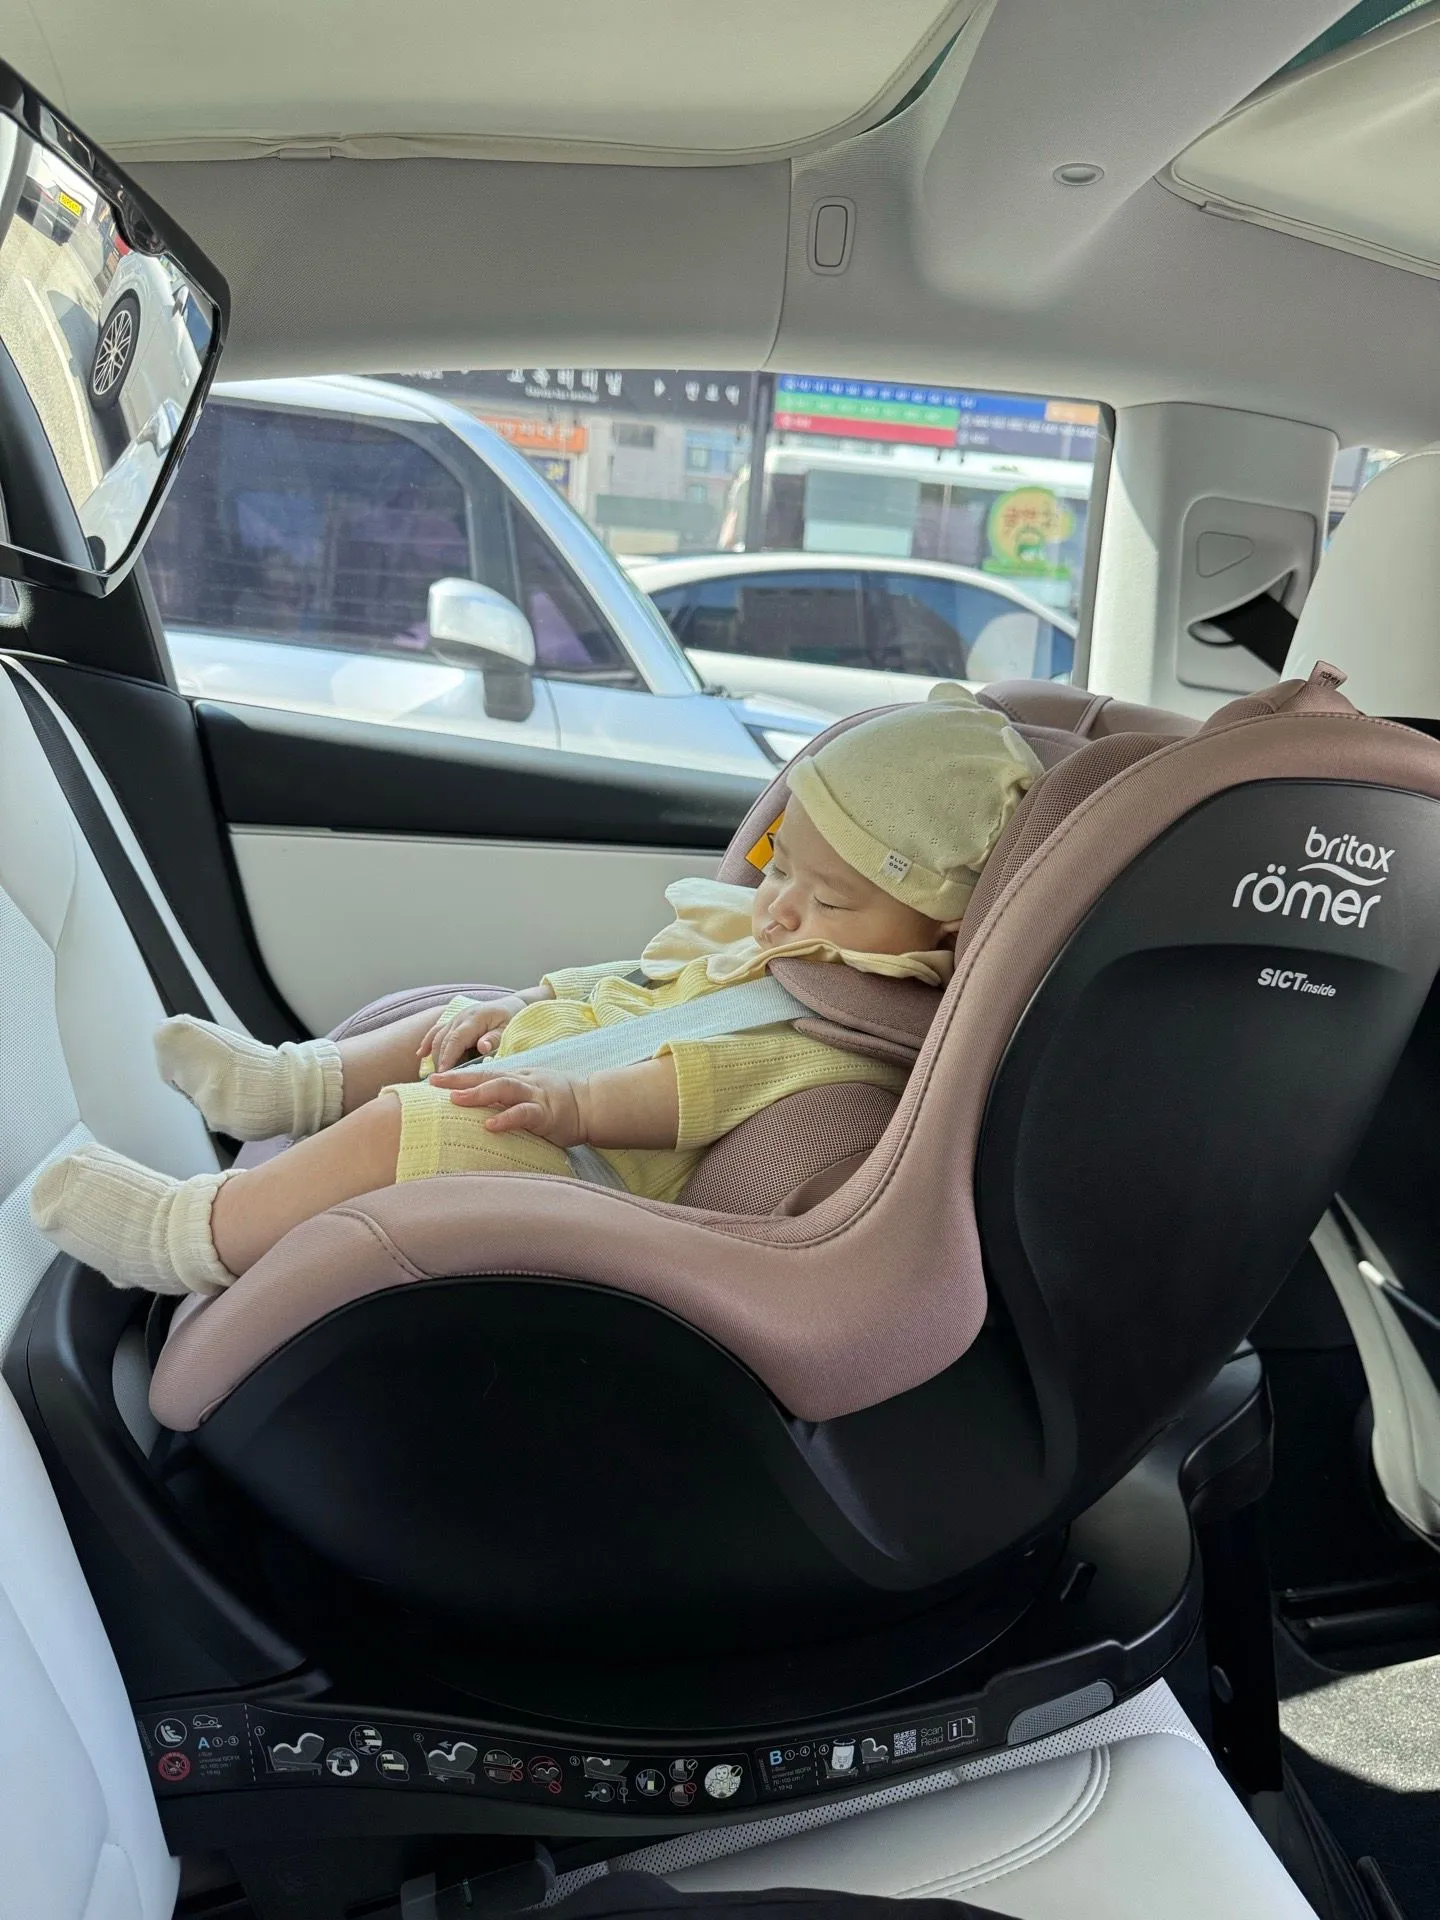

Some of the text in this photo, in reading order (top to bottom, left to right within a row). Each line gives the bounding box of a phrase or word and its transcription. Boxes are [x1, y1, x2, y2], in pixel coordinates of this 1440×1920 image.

[1304, 826, 1395, 873] britax
[1232, 863, 1382, 929] römer
[920, 1726, 943, 1738] Scan
[198, 1736, 210, 1750] A
[920, 1734, 944, 1747] Read
[769, 1750, 783, 1766] B
